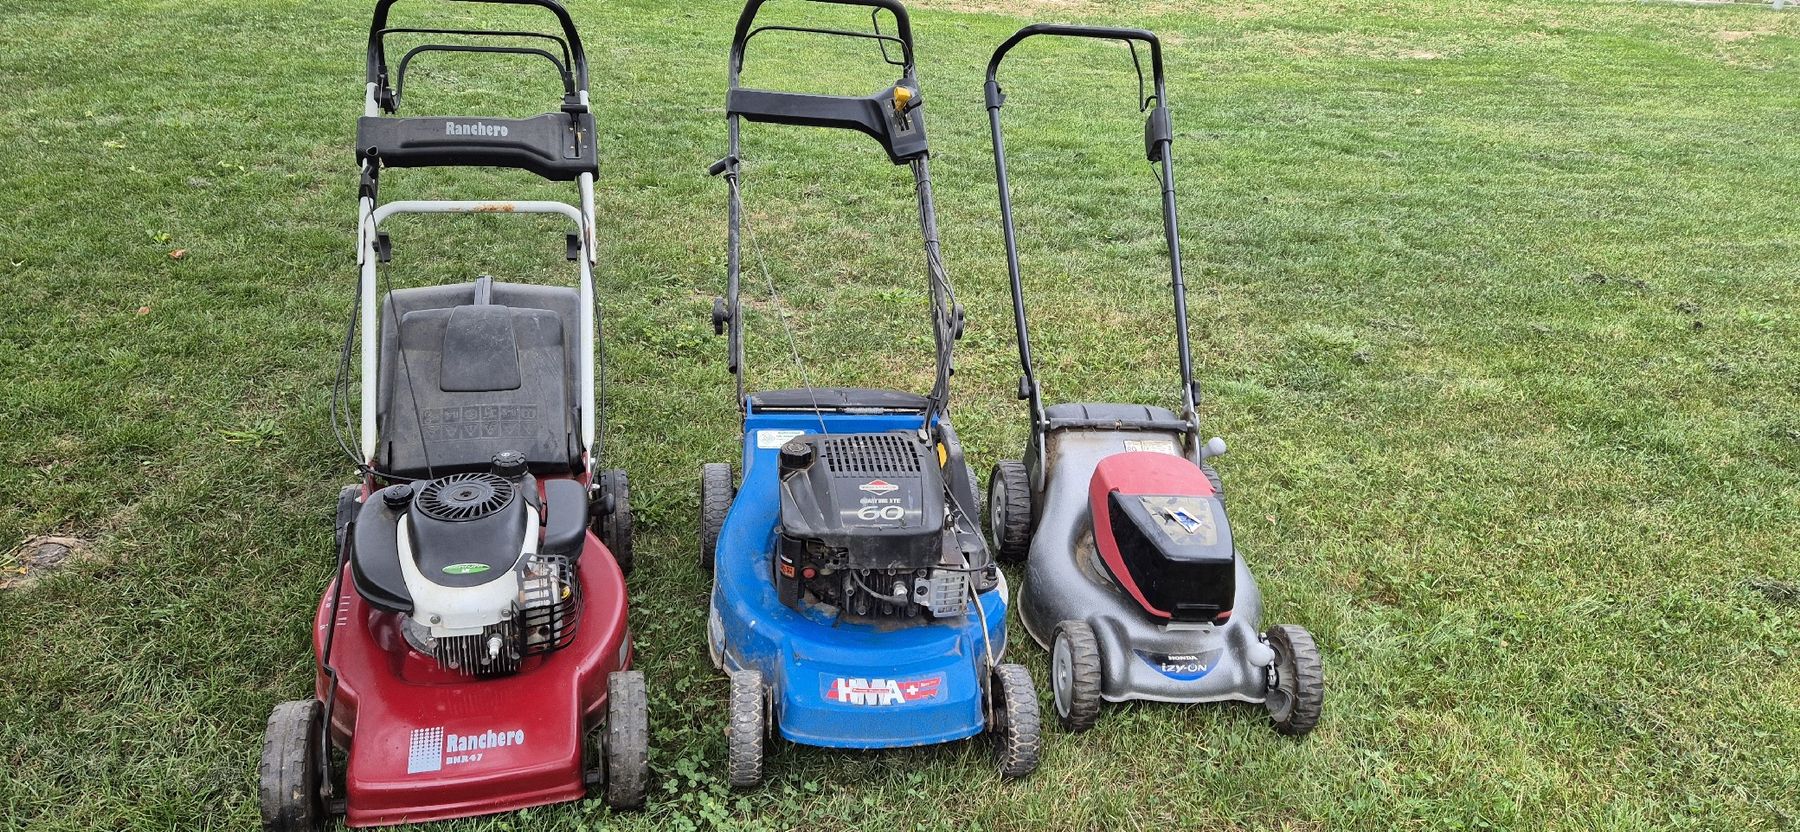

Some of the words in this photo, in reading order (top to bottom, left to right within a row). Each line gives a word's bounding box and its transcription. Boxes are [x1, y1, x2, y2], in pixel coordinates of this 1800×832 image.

[446, 121, 509, 137] Ranchero
[857, 505, 905, 520] 60
[446, 729, 525, 753] Ranchero
